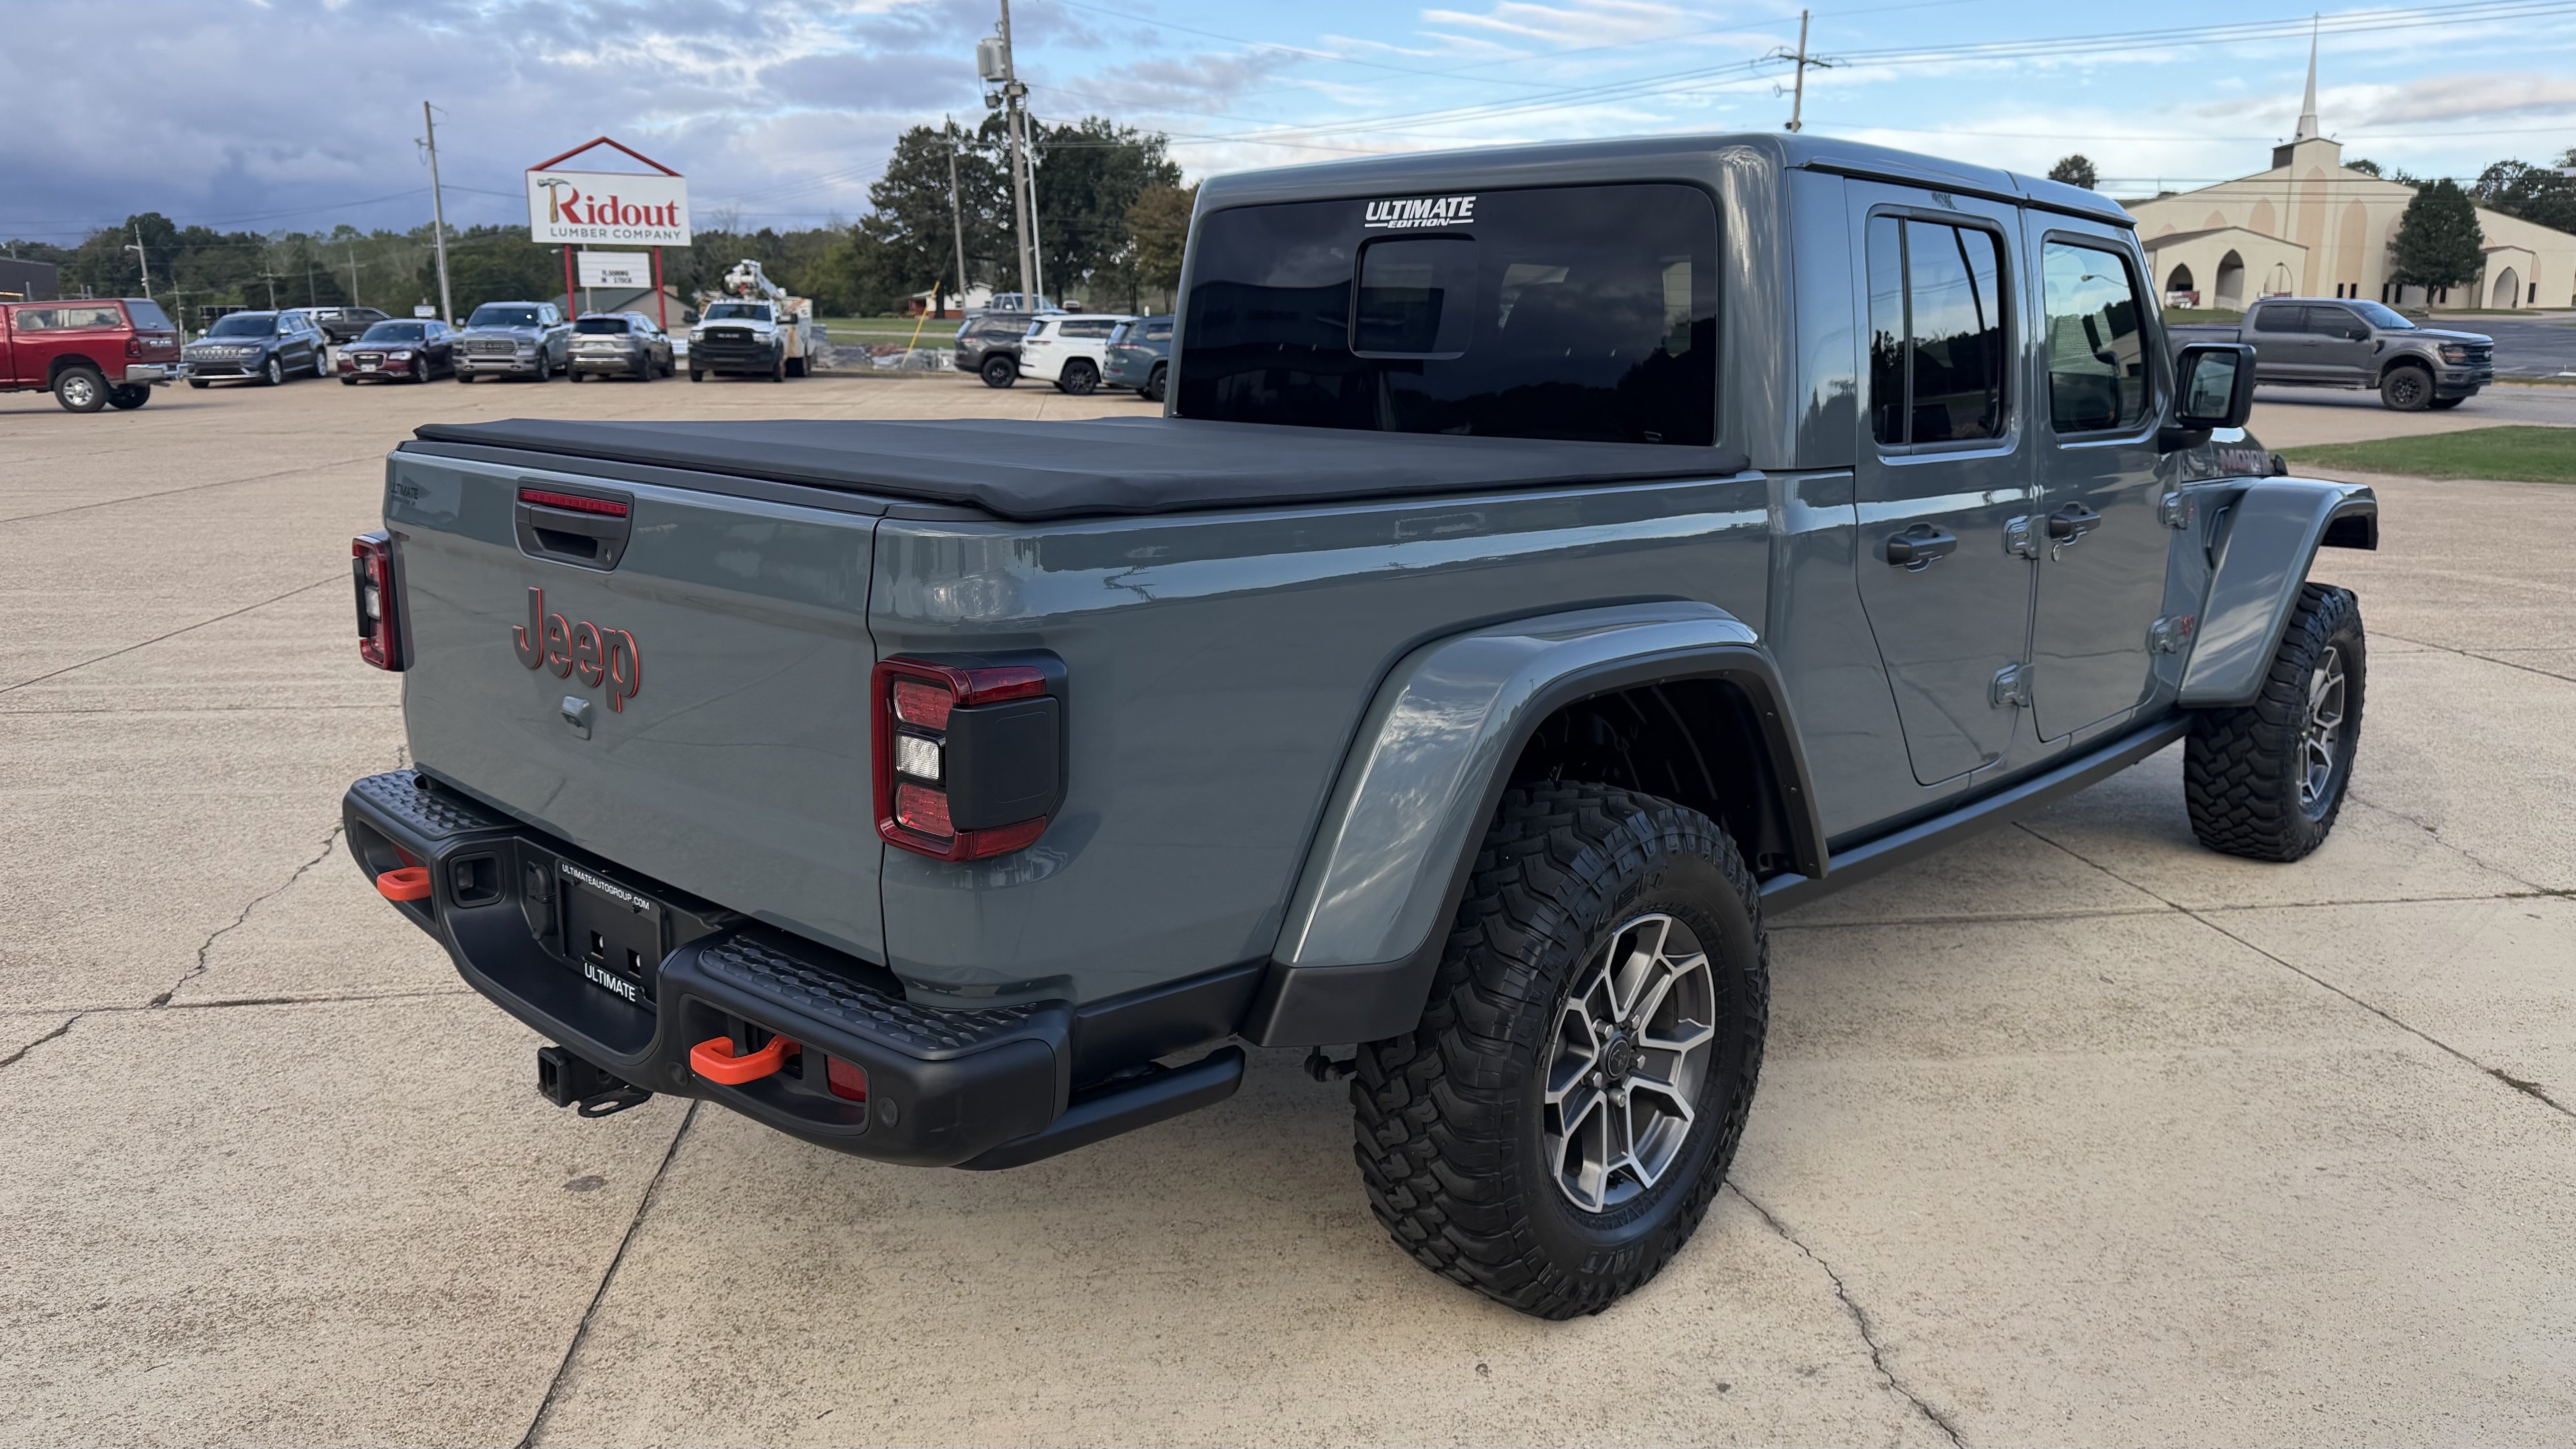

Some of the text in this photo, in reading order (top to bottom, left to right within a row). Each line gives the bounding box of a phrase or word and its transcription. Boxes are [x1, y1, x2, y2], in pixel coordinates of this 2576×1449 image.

[537, 177, 681, 227] Ridout
[1365, 196, 1477, 221] ULTIMATE
[550, 228, 681, 240] LUMBER COMPANY
[1387, 218, 1449, 228] EDITION
[511, 586, 640, 713] Jeep
[561, 863, 650, 911] ULTIMATEAUTOGROUP.COM
[584, 962, 636, 1003] ULTIMATE
